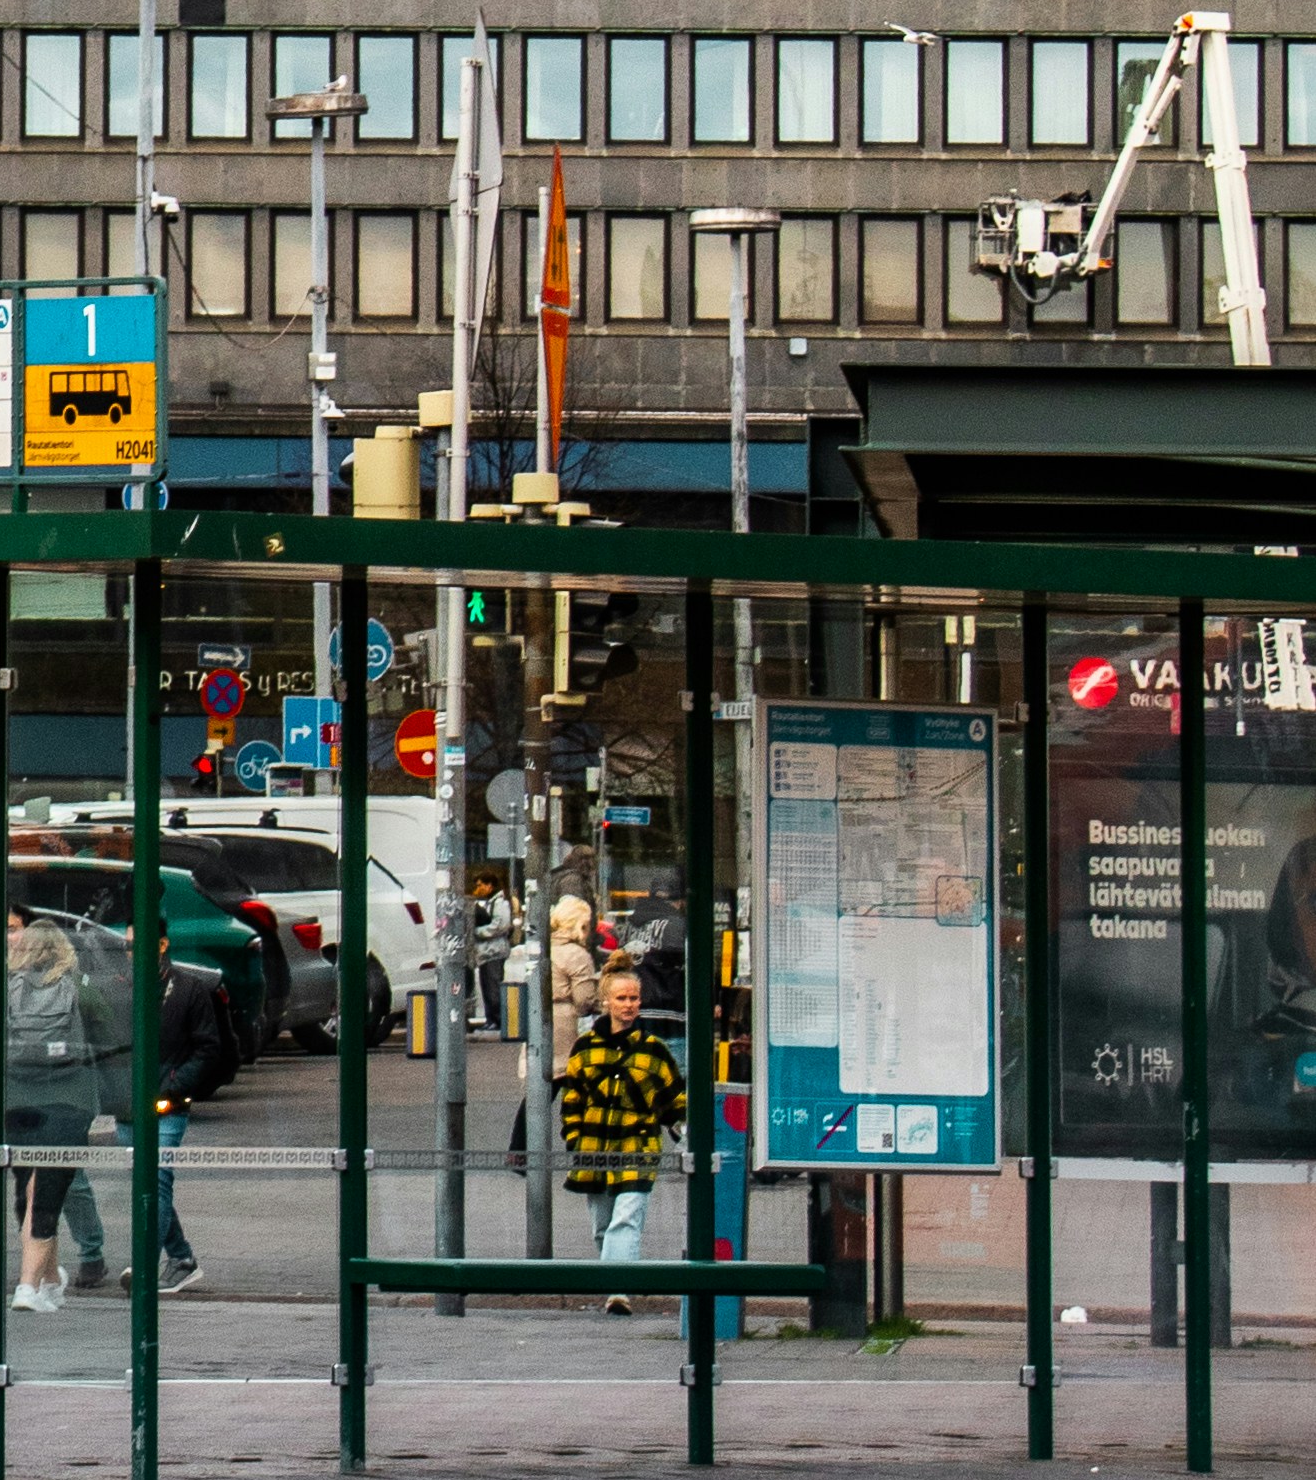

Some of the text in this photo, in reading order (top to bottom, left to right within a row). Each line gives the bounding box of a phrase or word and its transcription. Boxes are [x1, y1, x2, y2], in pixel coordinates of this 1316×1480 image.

[82, 303, 96, 357] 1
[115, 439, 154, 460] H2041
[184, 671, 252, 691] TAS
[1129, 658, 1263, 690] VAKU
[972, 720, 984, 736] A
[1088, 856, 1180, 880] saapuva
[1089, 882, 1266, 910] lähtevät ulman
[1089, 913, 1167, 939] takana
[1140, 1046, 1174, 1065] HSL
[1140, 1066, 1174, 1083] HRT
